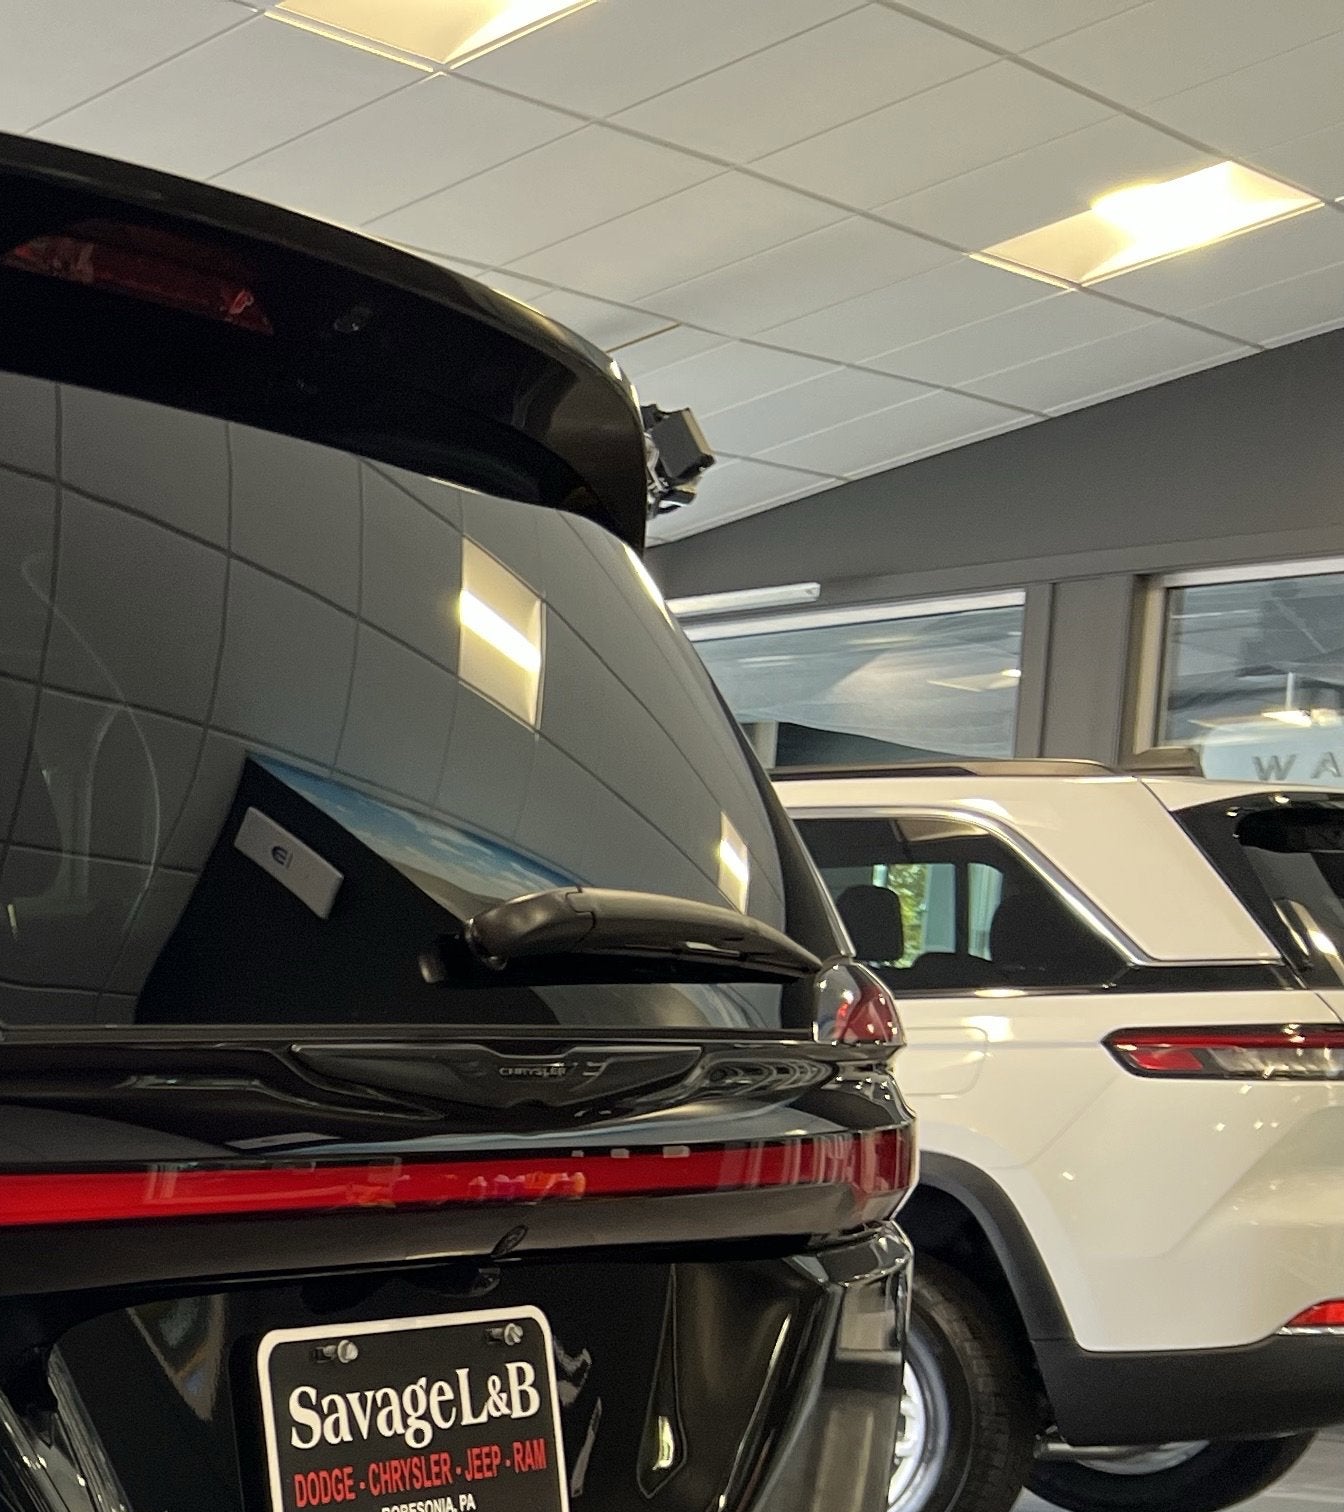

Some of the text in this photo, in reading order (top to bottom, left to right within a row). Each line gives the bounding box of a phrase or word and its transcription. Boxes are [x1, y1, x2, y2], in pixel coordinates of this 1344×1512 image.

[293, 1438, 546, 1508] DODGE CHRYSLER JEEP RAM
[459, 1493, 476, 1512] PA
